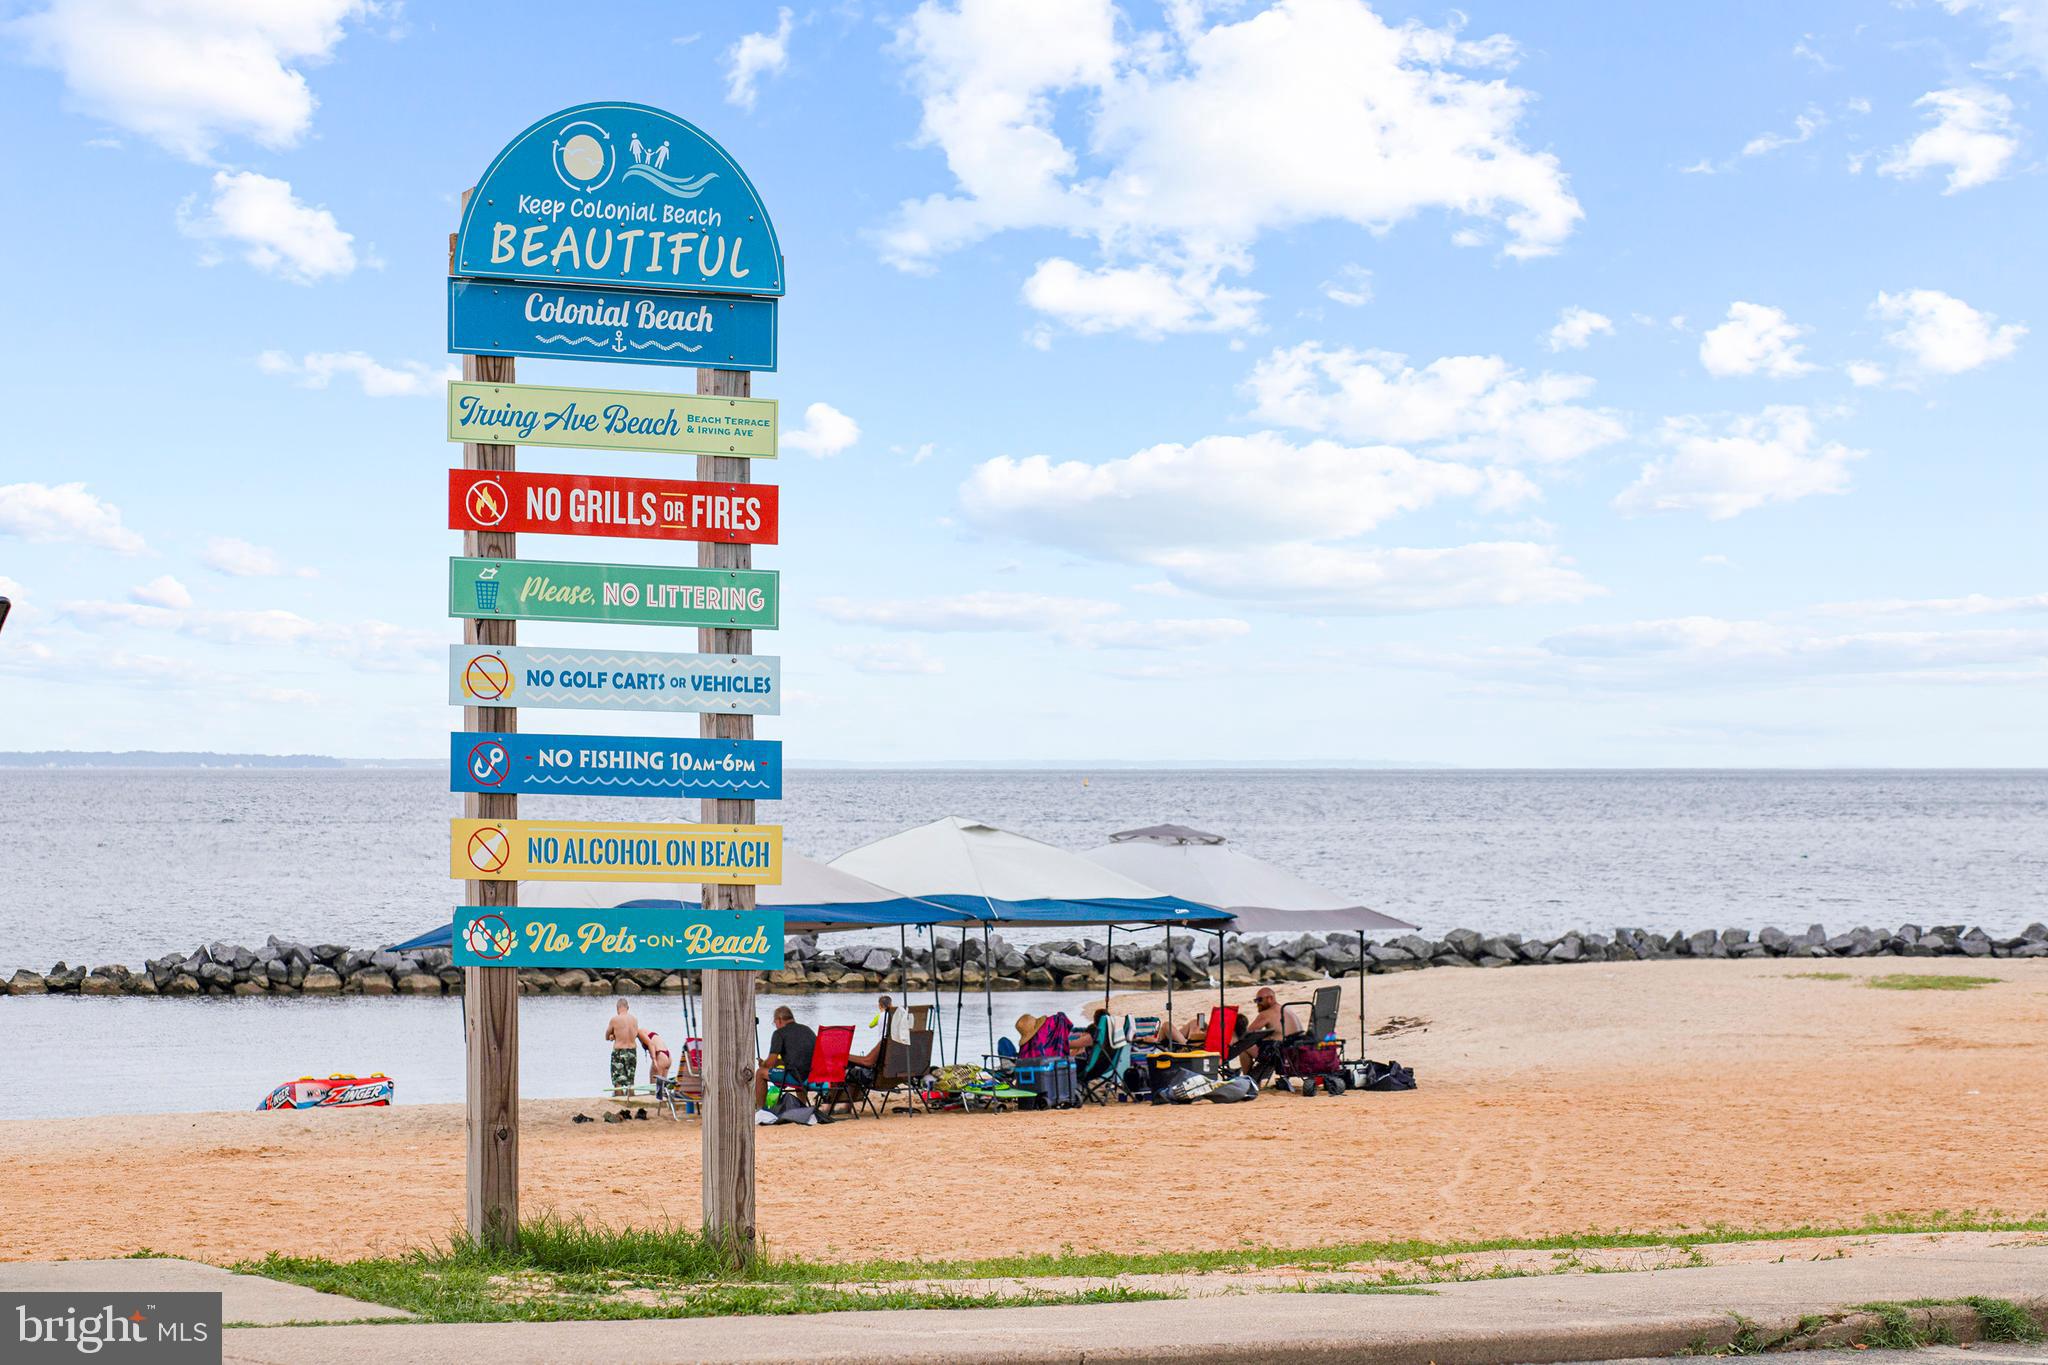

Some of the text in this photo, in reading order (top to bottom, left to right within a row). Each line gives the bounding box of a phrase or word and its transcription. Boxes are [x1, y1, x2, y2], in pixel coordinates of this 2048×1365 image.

[518, 194, 721, 227] Keep Colonial Beach
[490, 222, 750, 278] BEAUTIFUL
[525, 293, 713, 332] Colonial Beach
[459, 396, 680, 438] Irving Ave Beach
[686, 425, 695, 434] &
[526, 486, 761, 531] NO GRILLS OR FIRES
[520, 575, 765, 612] Please, NO LITTERING
[526, 669, 771, 694] NO GOLF CARTS OR VEHICLES
[538, 749, 573, 768] NO
[579, 749, 664, 770] FISHING
[528, 837, 769, 868] NO ALCOHOL ON BEACH
[525, 922, 573, 951] No
[577, 922, 637, 953] Pets
[683, 923, 771, 954] Beach
[318, 1084, 383, 1105] ZINGER
